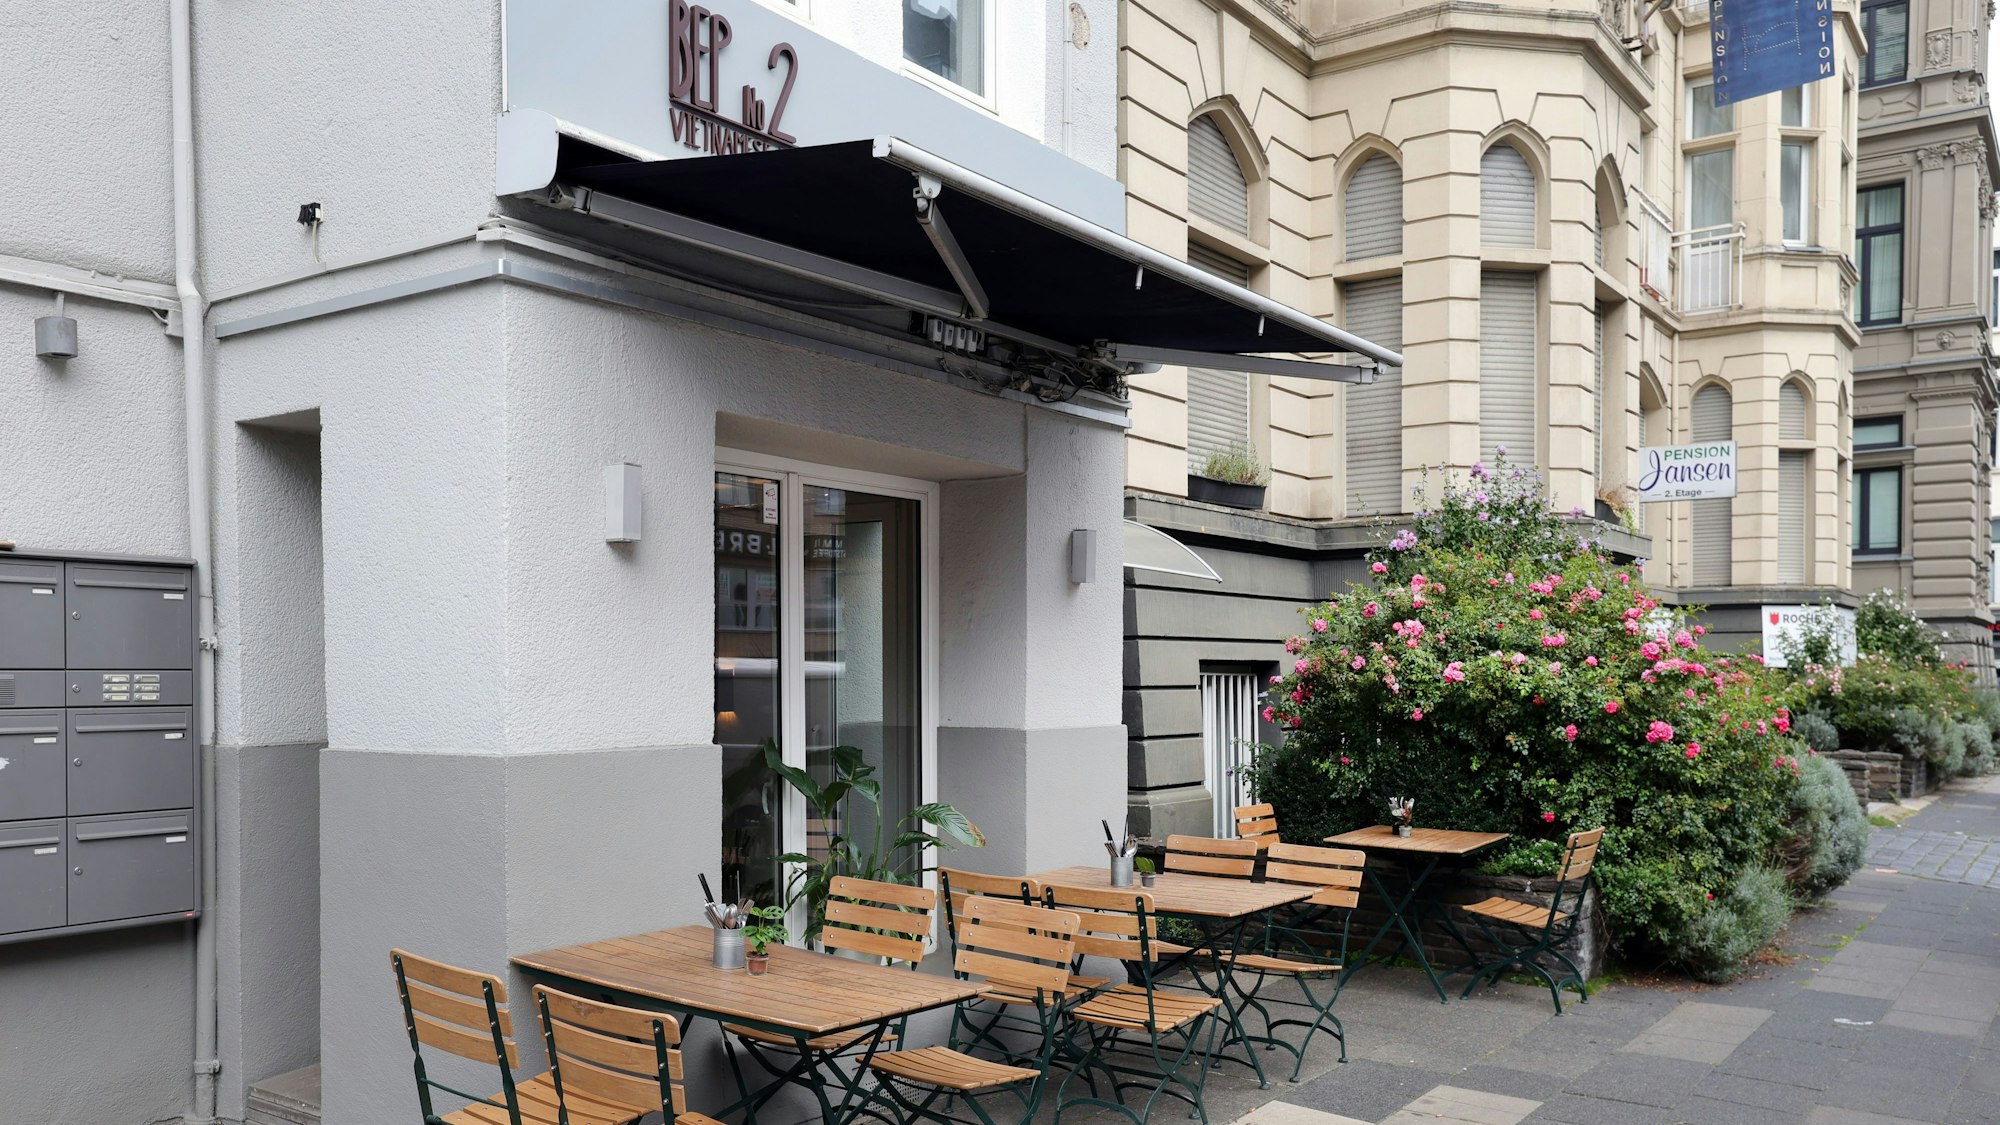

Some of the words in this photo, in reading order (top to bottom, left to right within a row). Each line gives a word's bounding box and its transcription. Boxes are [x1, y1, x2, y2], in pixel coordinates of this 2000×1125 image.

[767, 42, 797, 144] 2
[1664, 446, 1731, 461] PENSION
[1638, 449, 1732, 492] Jansen
[1664, 490, 1673, 498] 2.
[1675, 489, 1703, 498] Etage
